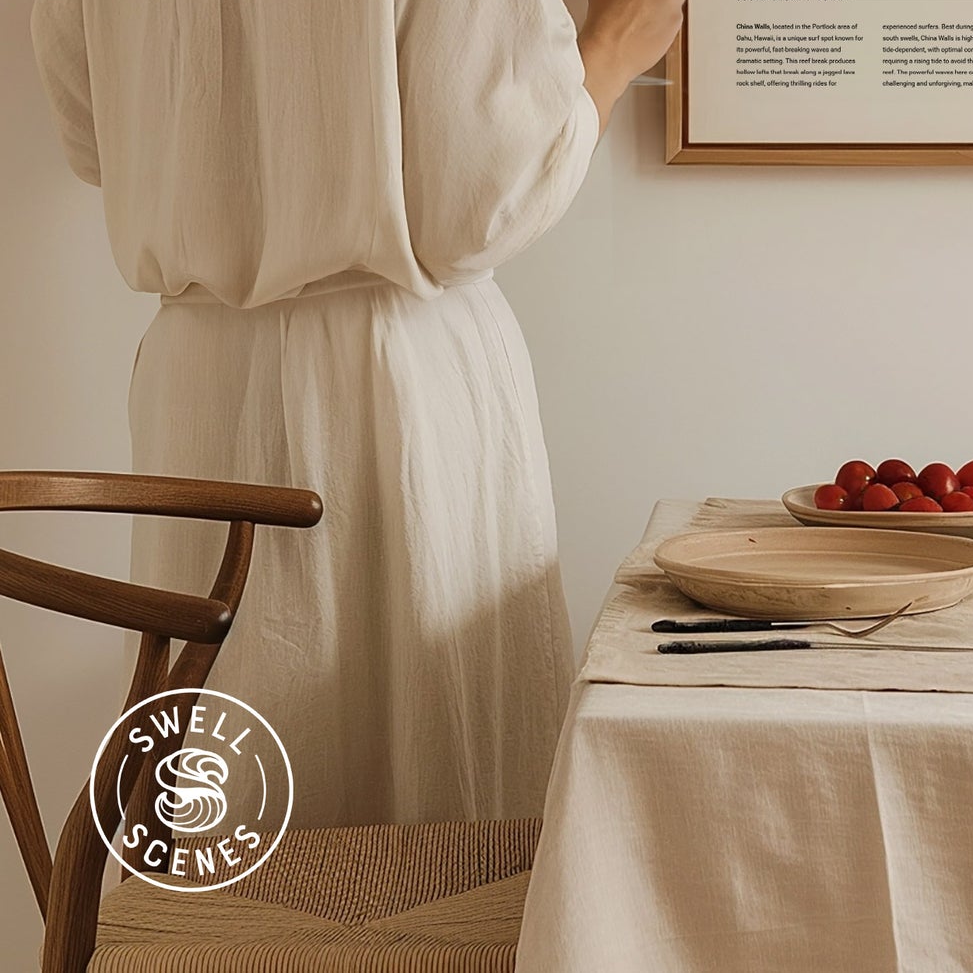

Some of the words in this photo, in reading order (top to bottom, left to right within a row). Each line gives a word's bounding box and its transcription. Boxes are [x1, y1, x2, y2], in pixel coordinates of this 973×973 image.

[882, 23, 917, 31] experienced
[955, 23, 973, 31] during
[788, 35, 807, 43] unique
[821, 35, 834, 43] spot
[941, 46, 963, 54] optimal
[767, 80, 789, 88] offering
[791, 80, 811, 88] thrilling
[882, 80, 915, 88] challenging
